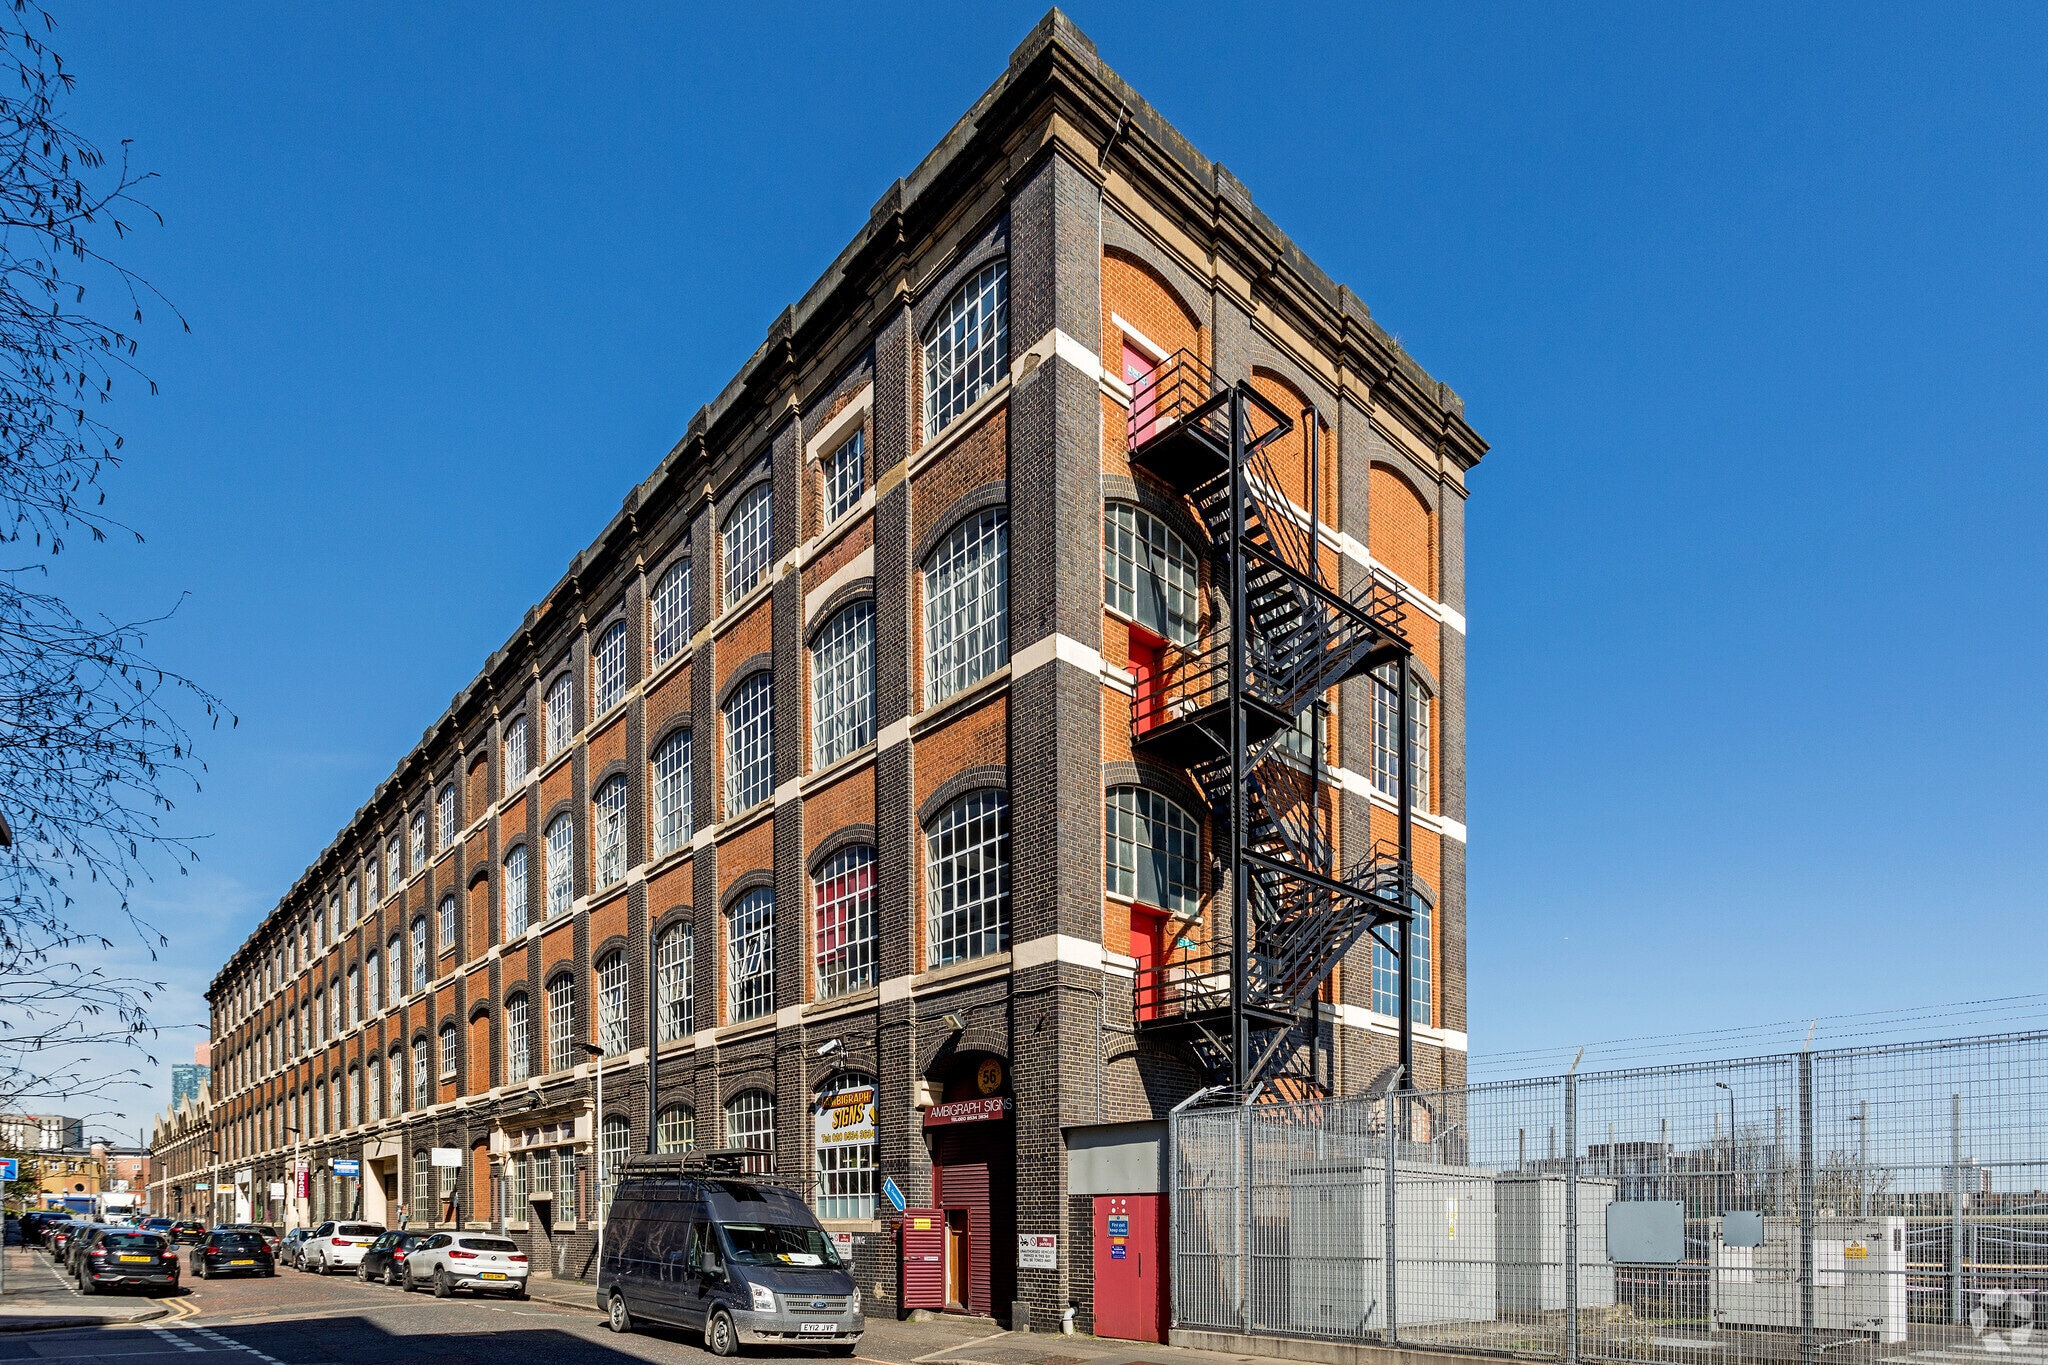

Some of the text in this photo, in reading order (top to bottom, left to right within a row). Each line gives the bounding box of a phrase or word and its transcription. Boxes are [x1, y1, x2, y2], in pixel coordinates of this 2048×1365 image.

[982, 1069, 997, 1084] 56
[824, 1092, 869, 1107] AMBIGRAPH
[930, 1098, 1013, 1118] AMBIGRAPH SIGNS
[832, 1103, 865, 1129] SIGNS
